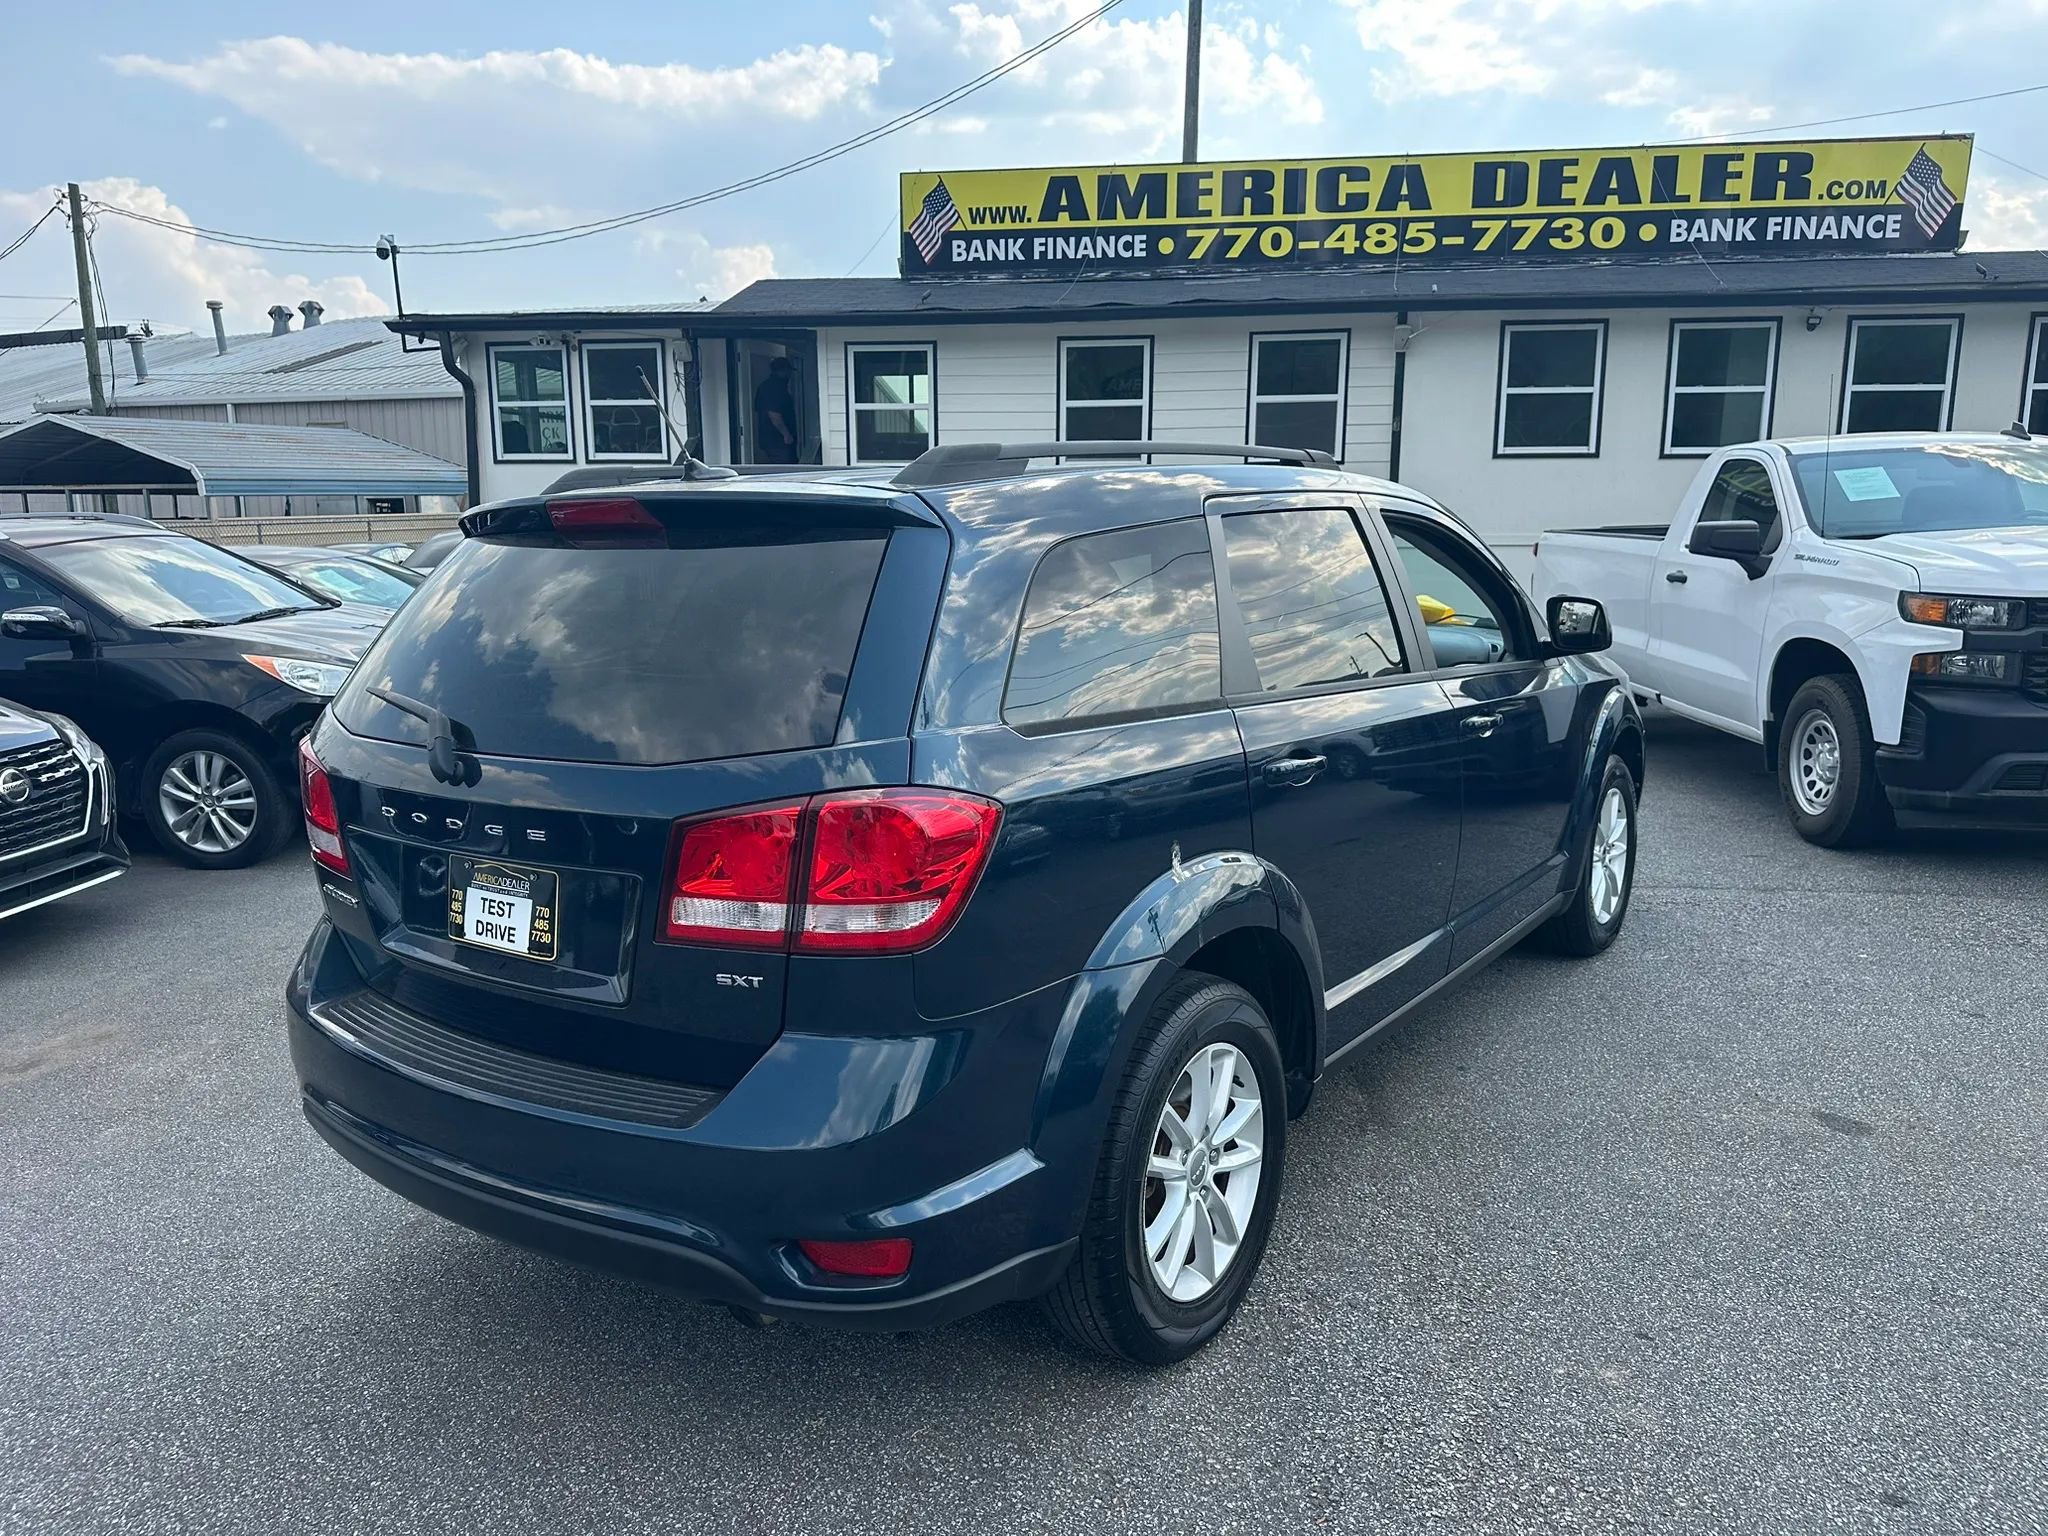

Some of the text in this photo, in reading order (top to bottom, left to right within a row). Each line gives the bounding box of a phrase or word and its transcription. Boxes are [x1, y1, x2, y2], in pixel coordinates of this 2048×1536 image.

[1669, 213, 1902, 243] BANK FINANCE
[1185, 216, 1627, 260] 770-485-7730
[951, 234, 1147, 263] BANK FINANCE
[381, 805, 547, 842] DODGE
[451, 888, 463, 901] 770
[451, 901, 463, 913] 485
[481, 897, 515, 918] TEST
[535, 906, 550, 919] 770
[449, 911, 463, 925] 7730
[533, 918, 550, 931] 485
[475, 919, 516, 943] DRIVE
[531, 930, 552, 944] 7730
[715, 973, 764, 989] SXT
